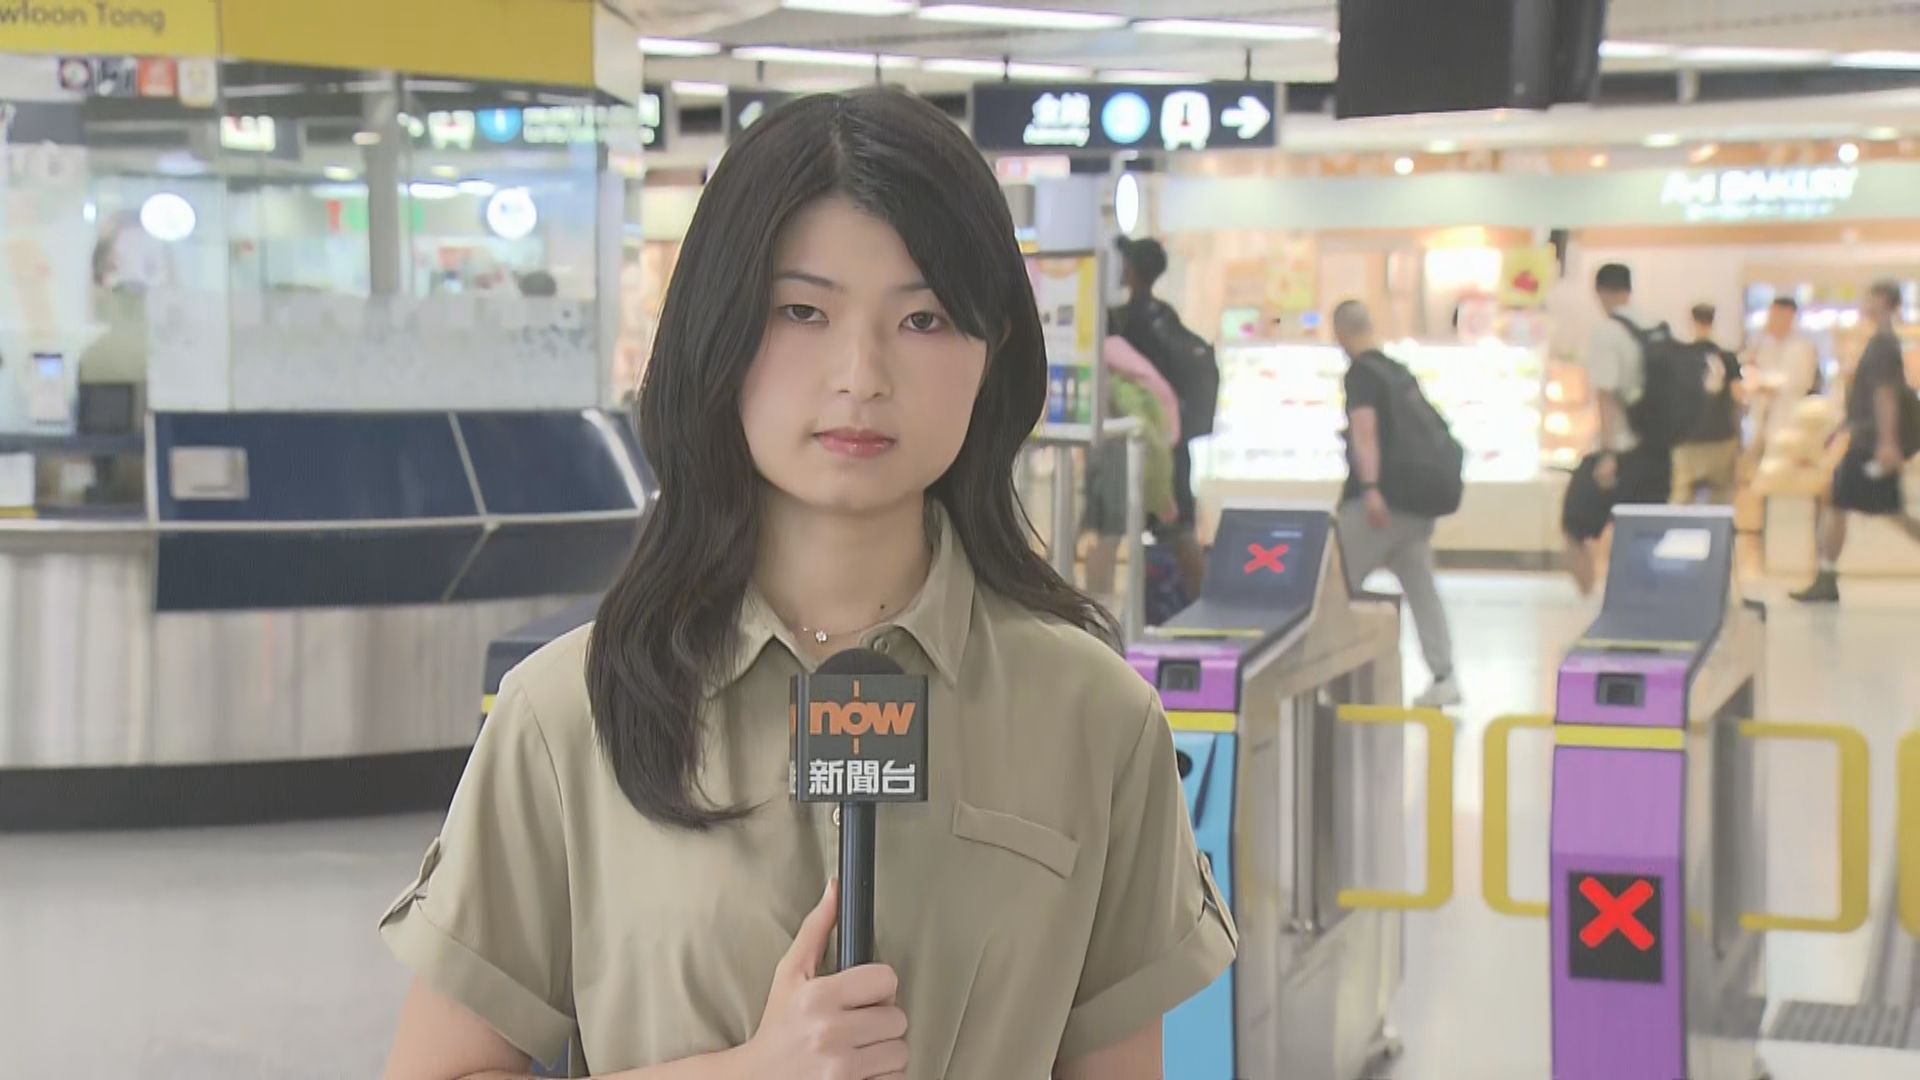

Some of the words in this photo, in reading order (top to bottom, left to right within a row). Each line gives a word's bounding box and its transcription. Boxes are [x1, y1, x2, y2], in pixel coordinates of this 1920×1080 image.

[96, 1, 166, 35] Tong
[809, 701, 916, 735] now
[809, 759, 916, 795] 新聞台
